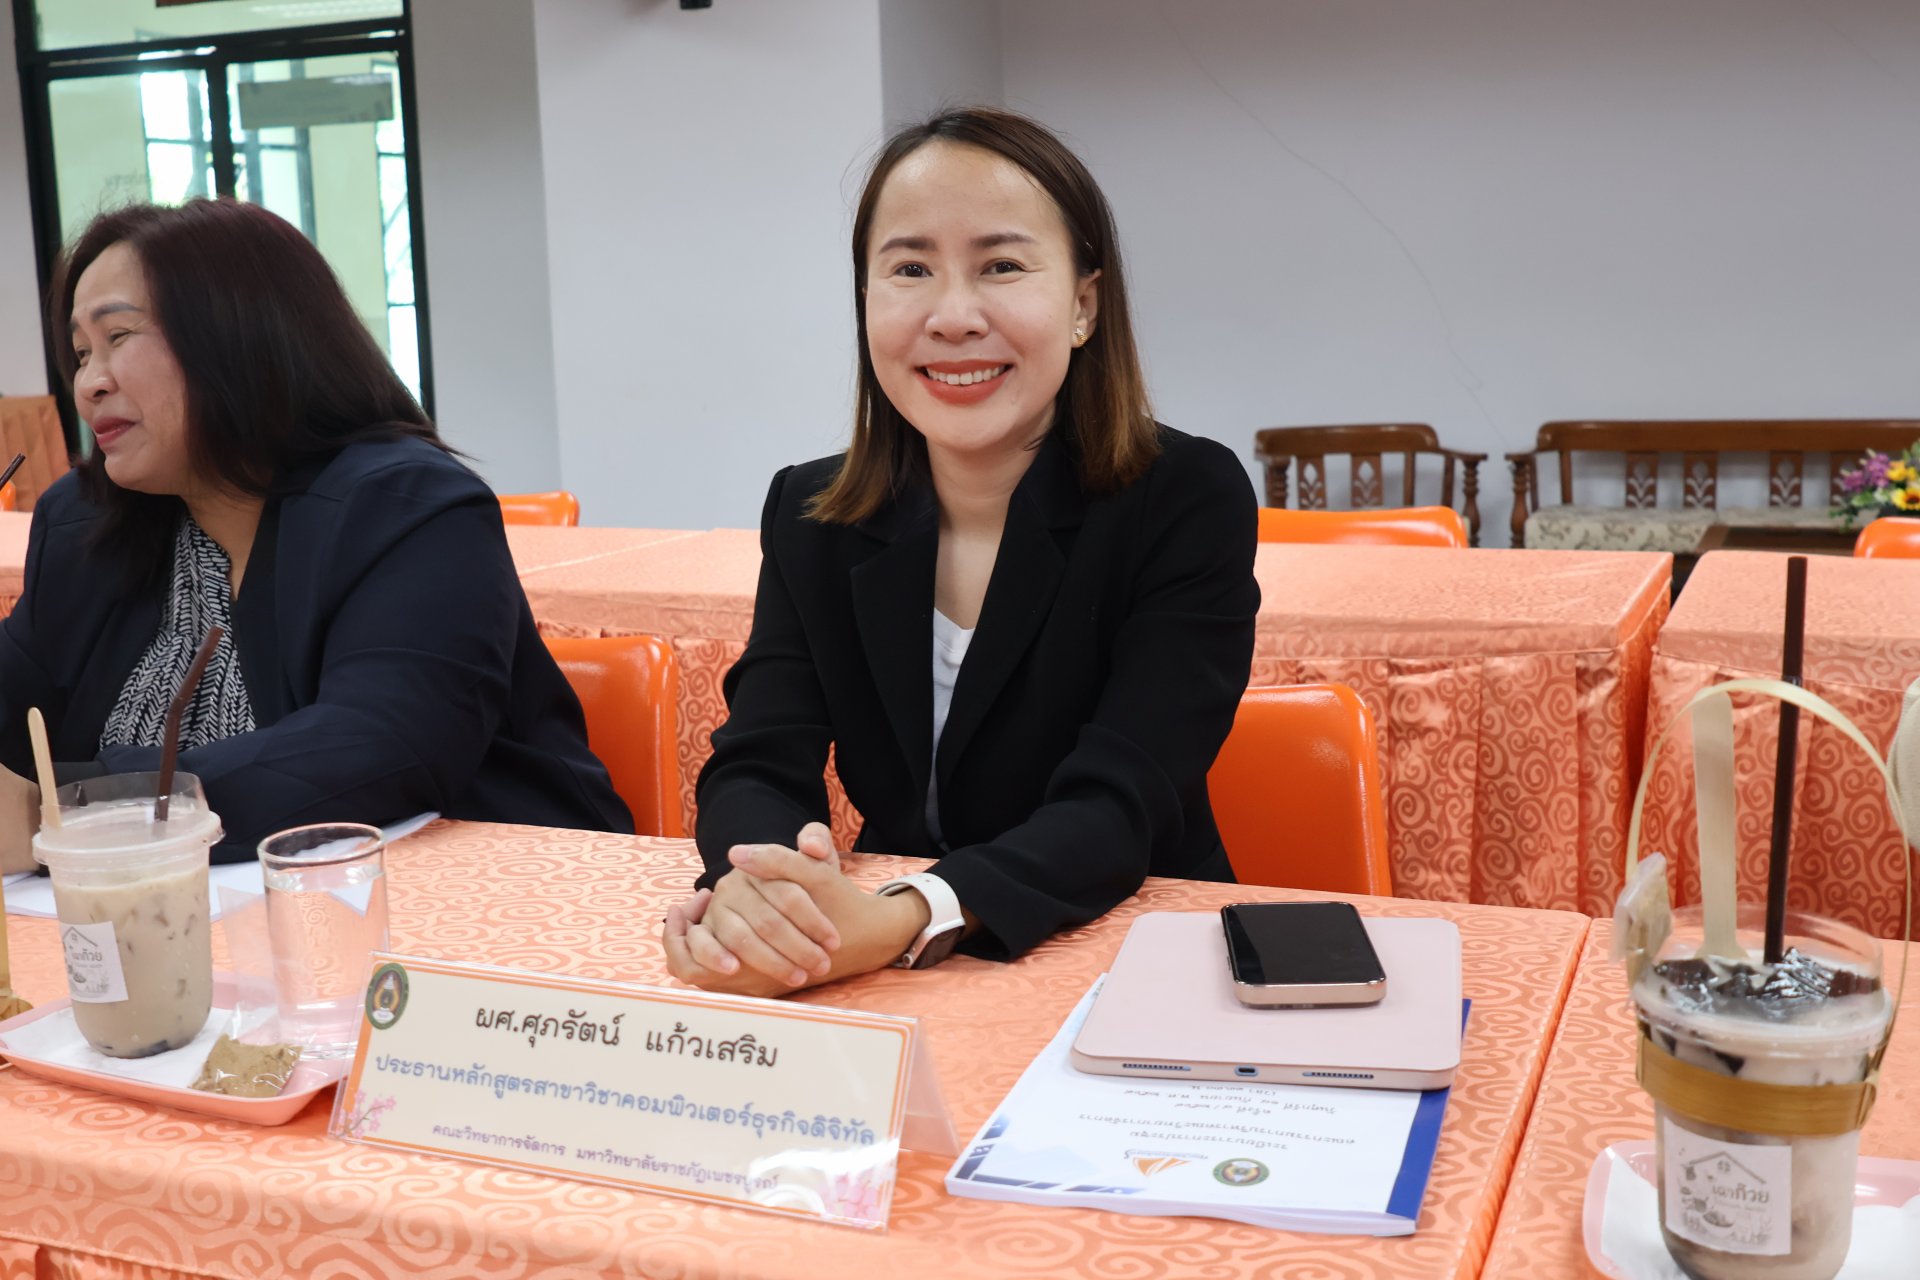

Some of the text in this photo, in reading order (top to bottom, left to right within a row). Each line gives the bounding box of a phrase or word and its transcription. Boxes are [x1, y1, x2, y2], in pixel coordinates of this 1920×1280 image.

[476, 1007, 778, 1068] ผศ.ศุภรัตน์ แก้วเสริม
[376, 1054, 875, 1146] ประธานหลักสูตรสาขาวิชาคอมพิวเตอร์ธุรกิจดิจิทัล
[432, 1124, 567, 1156] คณะวิทยาการจัดการ
